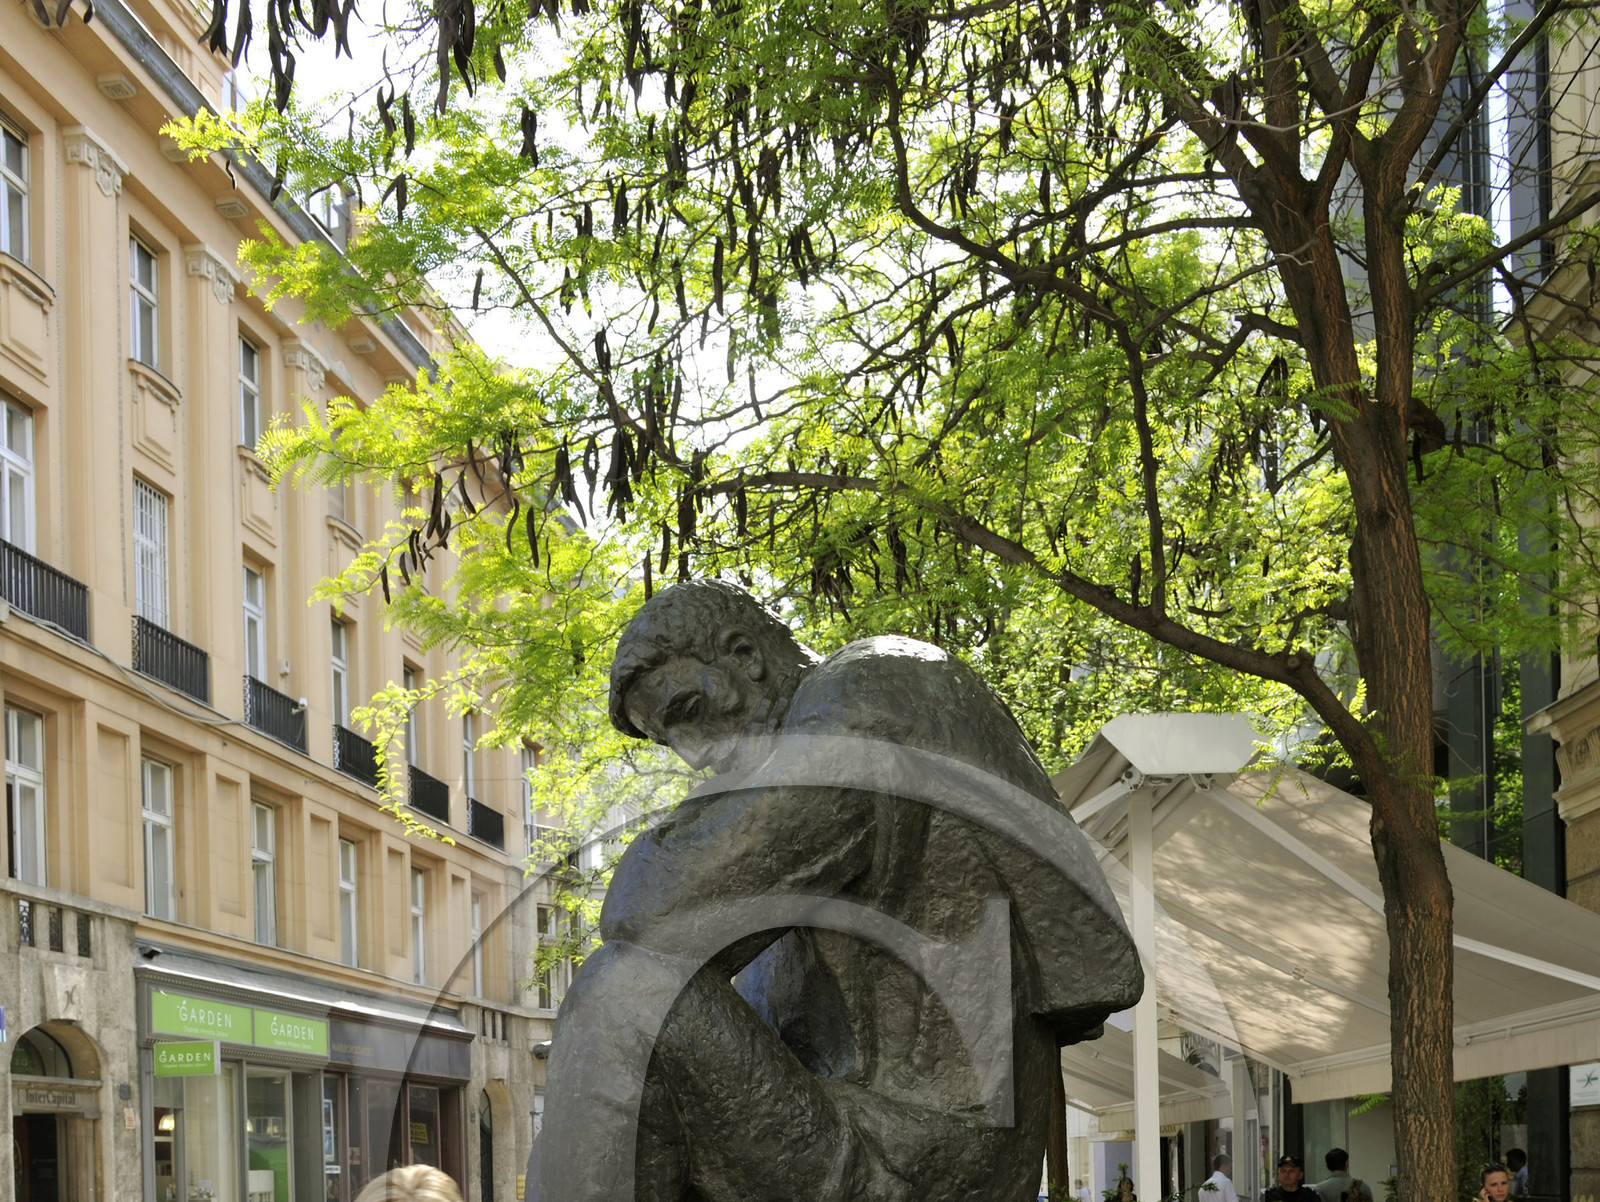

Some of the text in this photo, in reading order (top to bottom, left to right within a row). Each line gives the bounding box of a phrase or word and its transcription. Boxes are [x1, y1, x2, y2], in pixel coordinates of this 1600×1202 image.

[179, 1005, 232, 1029] GARDEN
[270, 1021, 315, 1041] GARDEN
[158, 1051, 211, 1064] GARDEN
[26, 1088, 75, 1108] InterCapital
